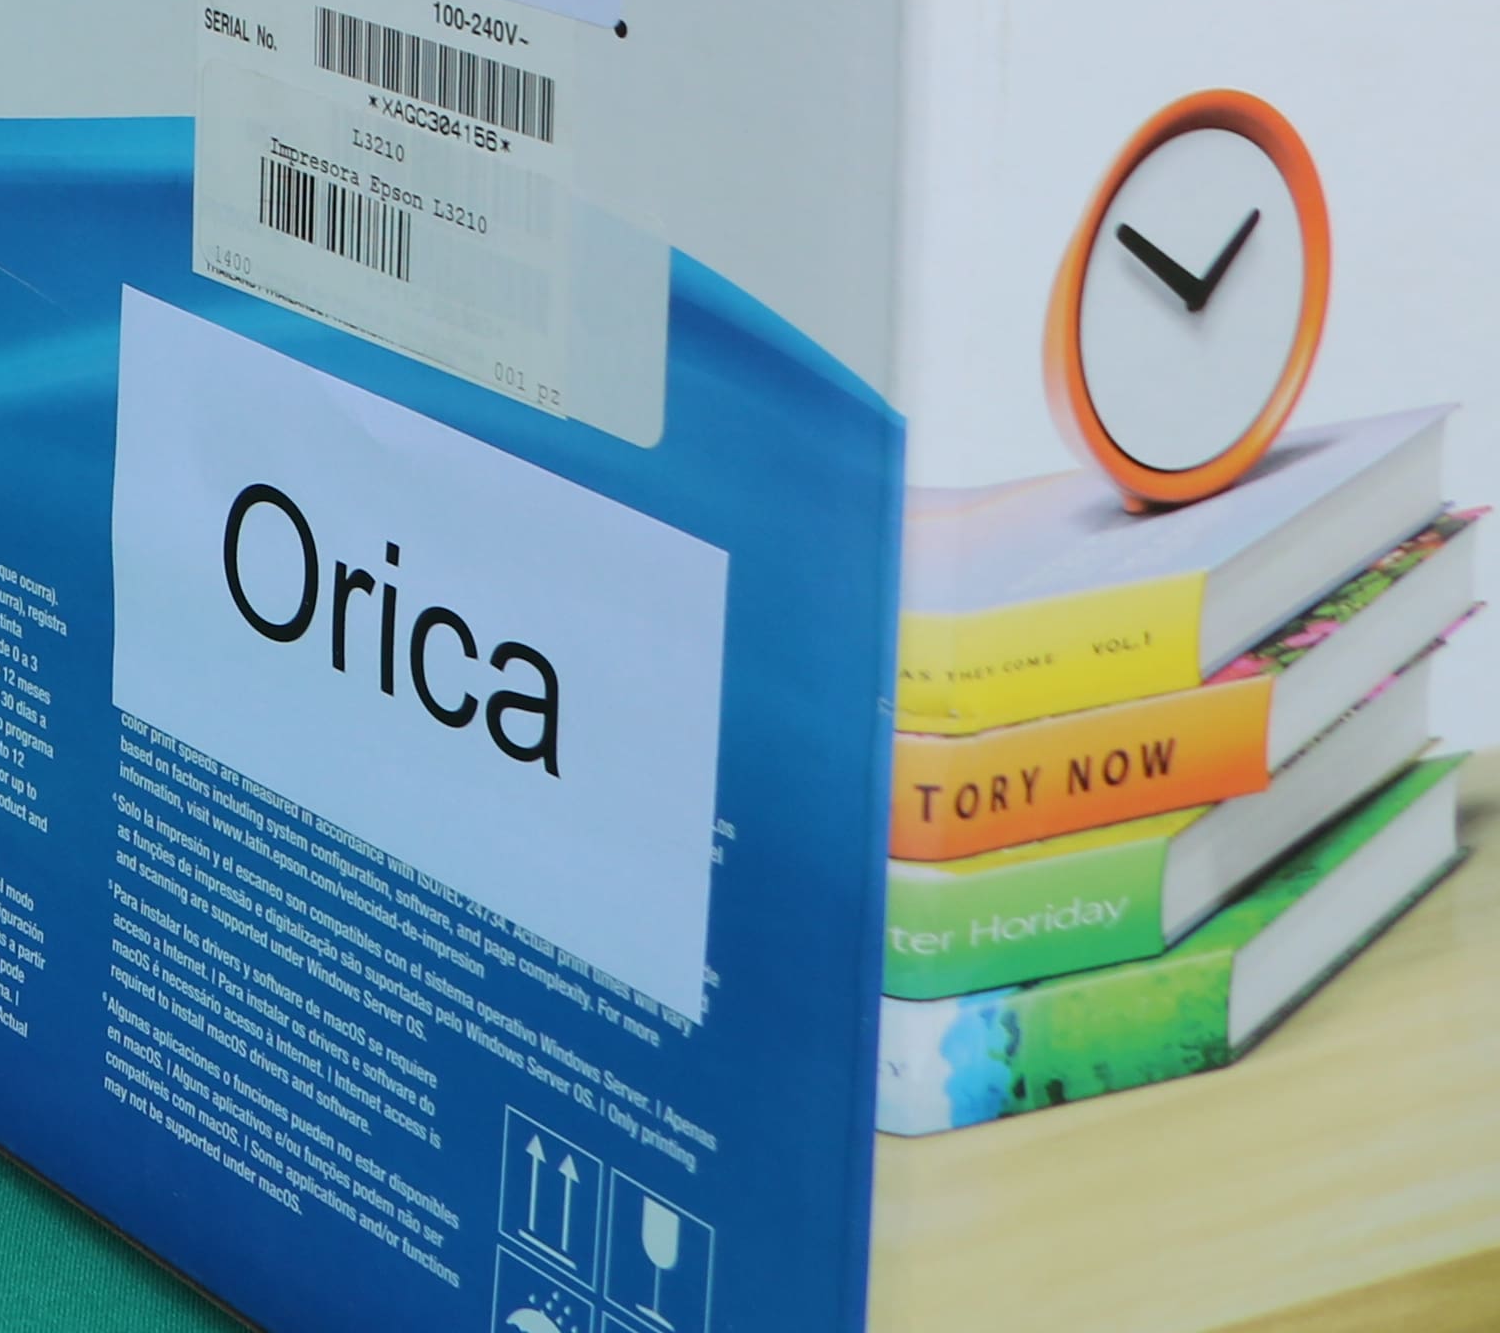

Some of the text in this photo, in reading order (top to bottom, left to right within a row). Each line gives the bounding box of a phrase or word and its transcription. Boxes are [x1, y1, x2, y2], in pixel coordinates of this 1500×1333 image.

[204, 8, 279, 53] SERIAL No.
[269, 135, 489, 236] Impresora Epson L3210
[351, 129, 407, 165] L3210
[221, 481, 565, 781] Orica
[915, 737, 1178, 825] TORY NOW
[104, 1077, 127, 1103] may
[129, 1090, 148, 1114] not
[149, 1101, 163, 1123] be
[165, 1115, 220, 1162] supported
[223, 1152, 257, 1184] under
